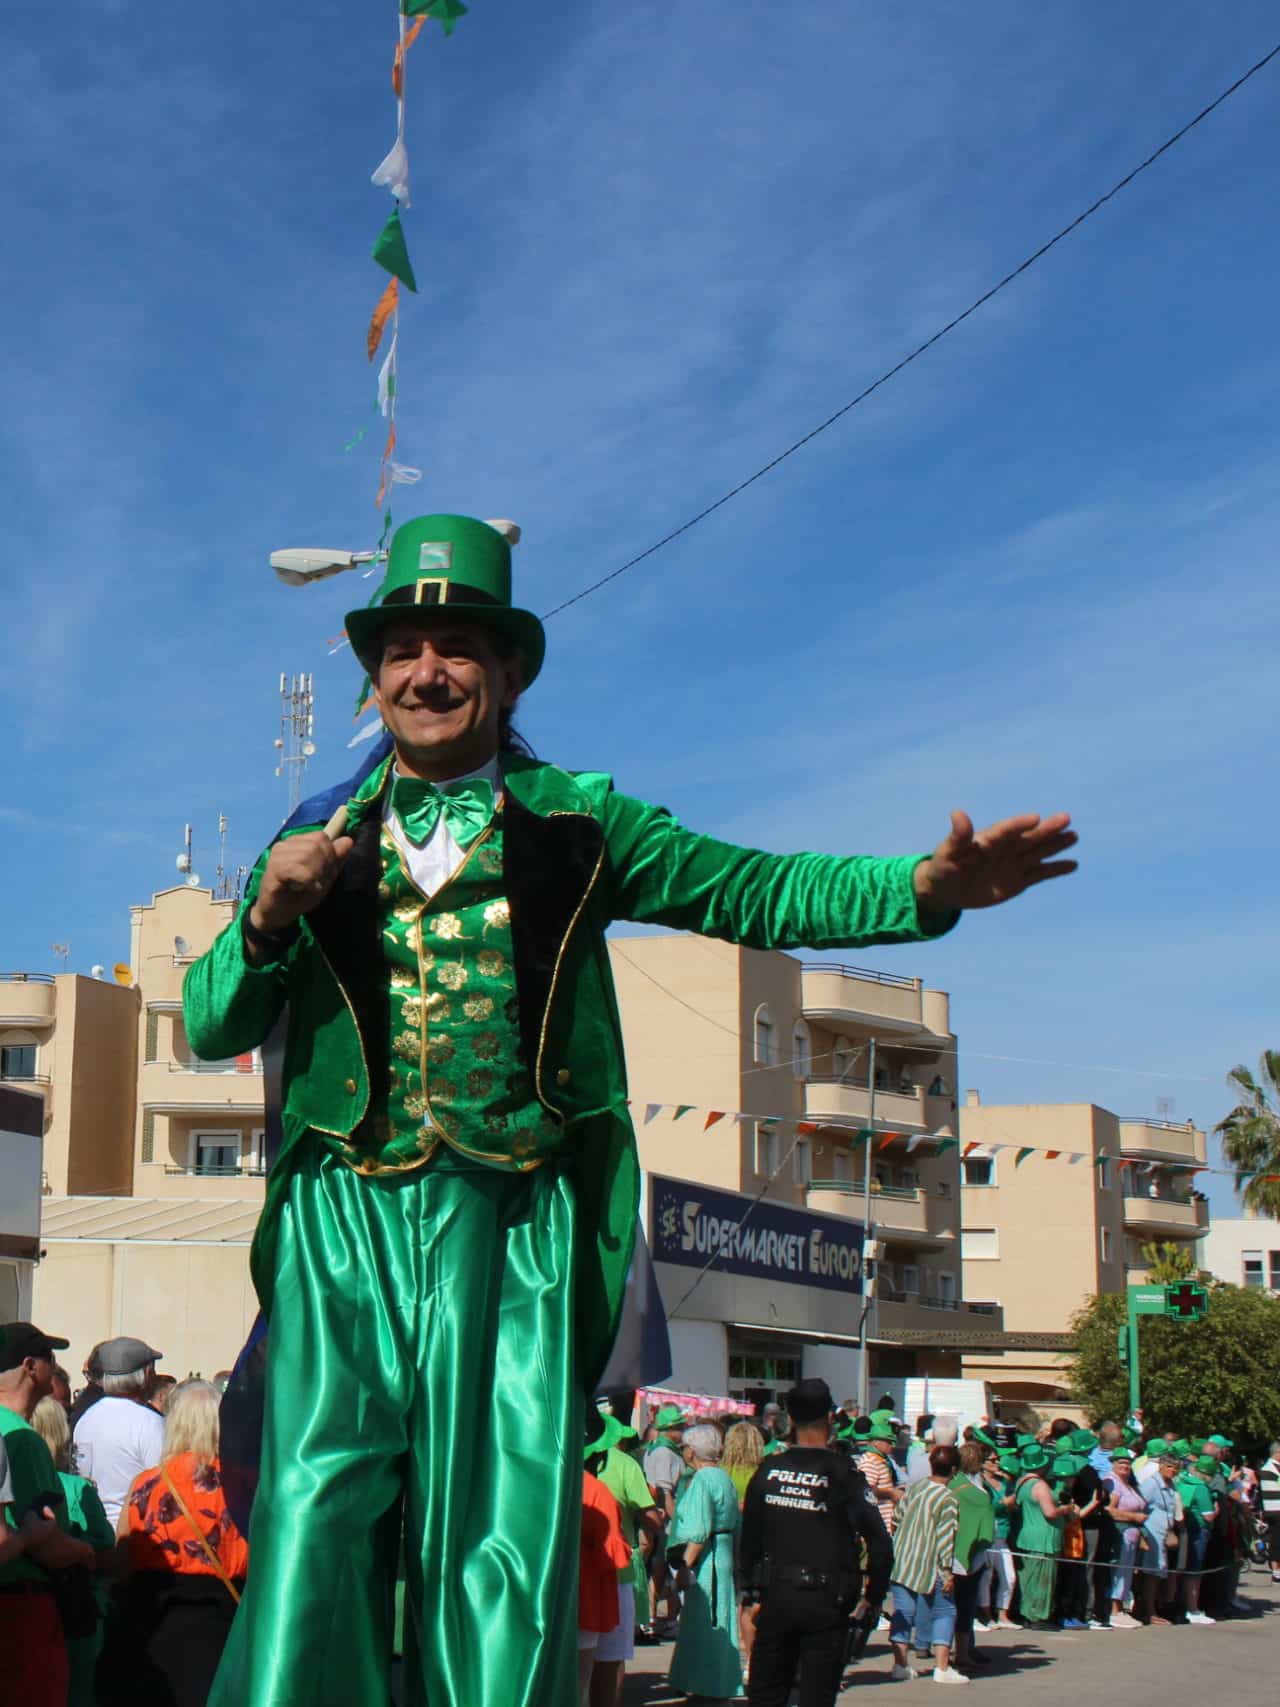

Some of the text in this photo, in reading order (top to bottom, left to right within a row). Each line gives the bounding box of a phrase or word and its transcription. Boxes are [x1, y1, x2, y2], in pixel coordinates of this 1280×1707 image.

[682, 1201, 862, 1280] SUPERMARKET EUROP
[767, 1468, 829, 1488] POLICIA
[780, 1485, 812, 1497] LOCAL
